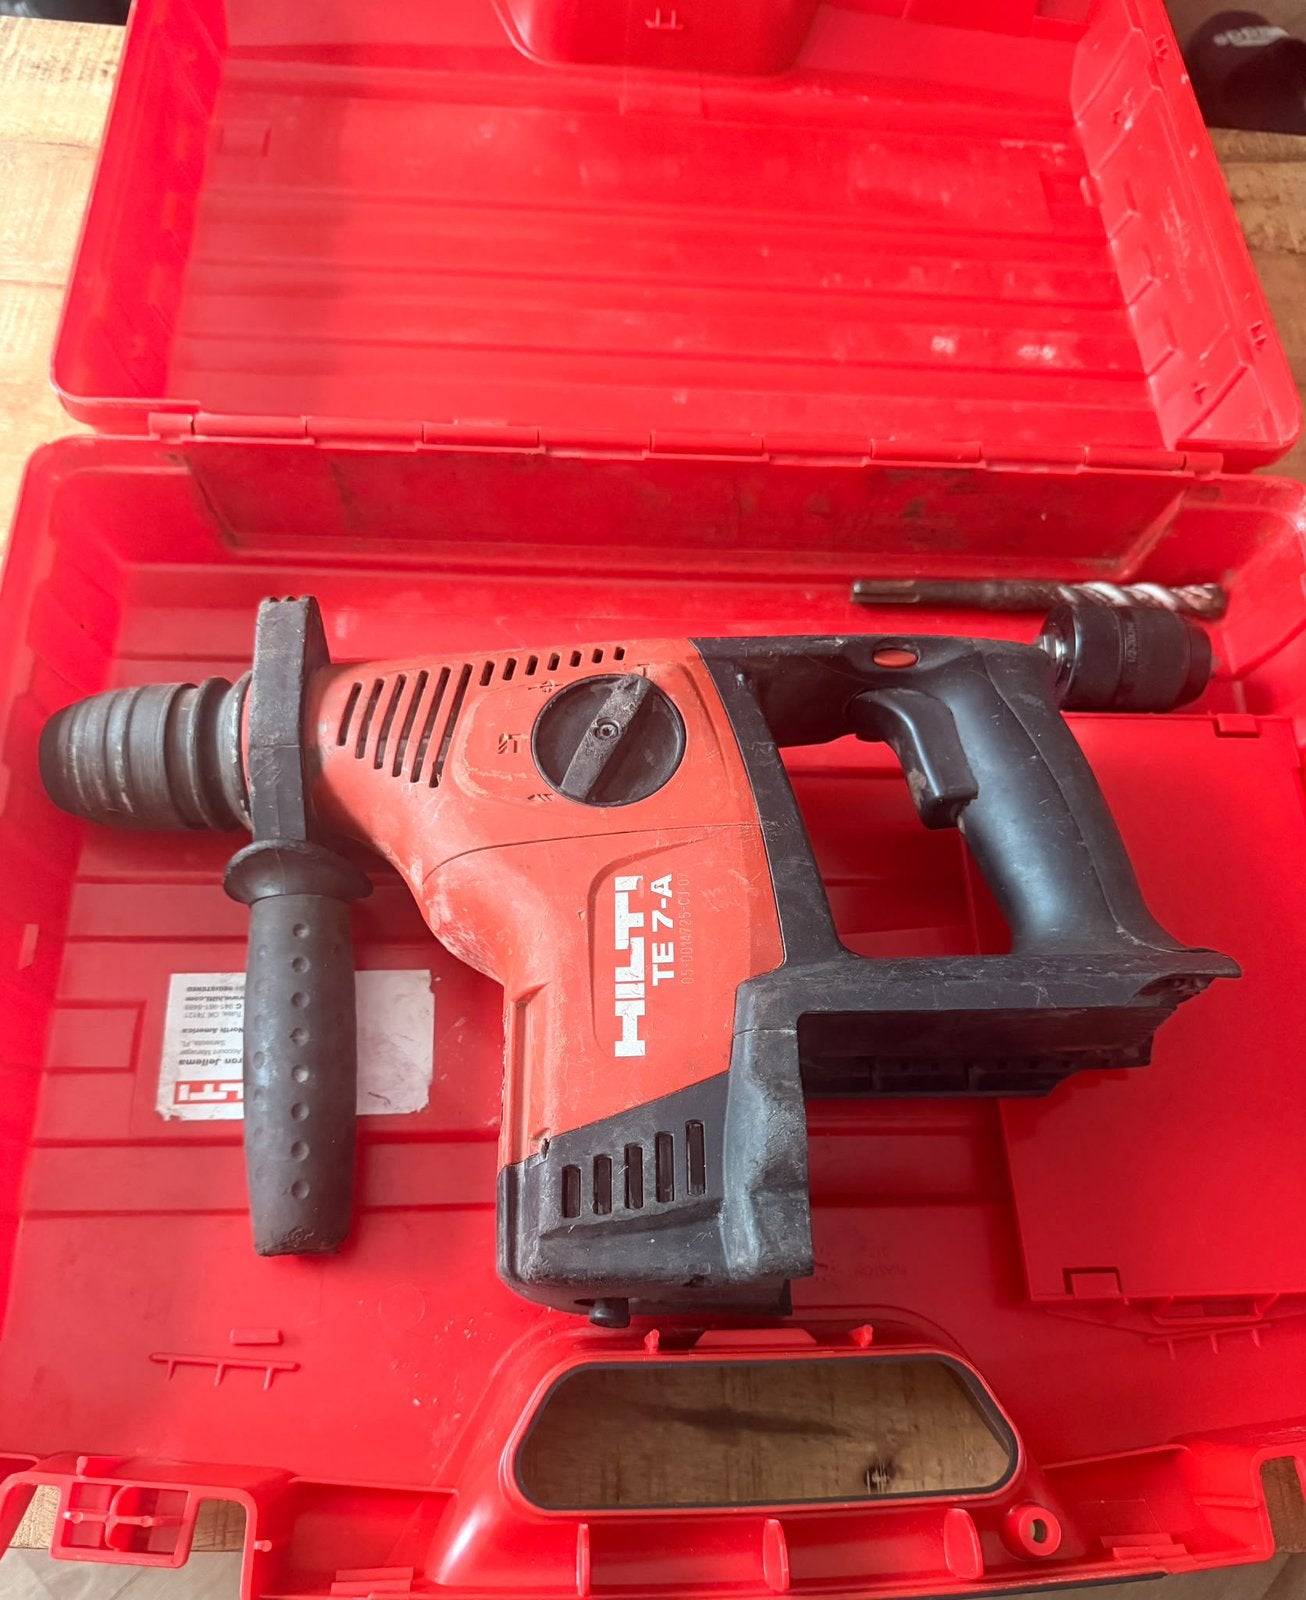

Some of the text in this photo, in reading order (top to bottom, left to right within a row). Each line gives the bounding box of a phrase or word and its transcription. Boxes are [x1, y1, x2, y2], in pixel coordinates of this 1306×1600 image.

[614, 875, 646, 1057] HILTI
[650, 874, 675, 986] TE 7-A
